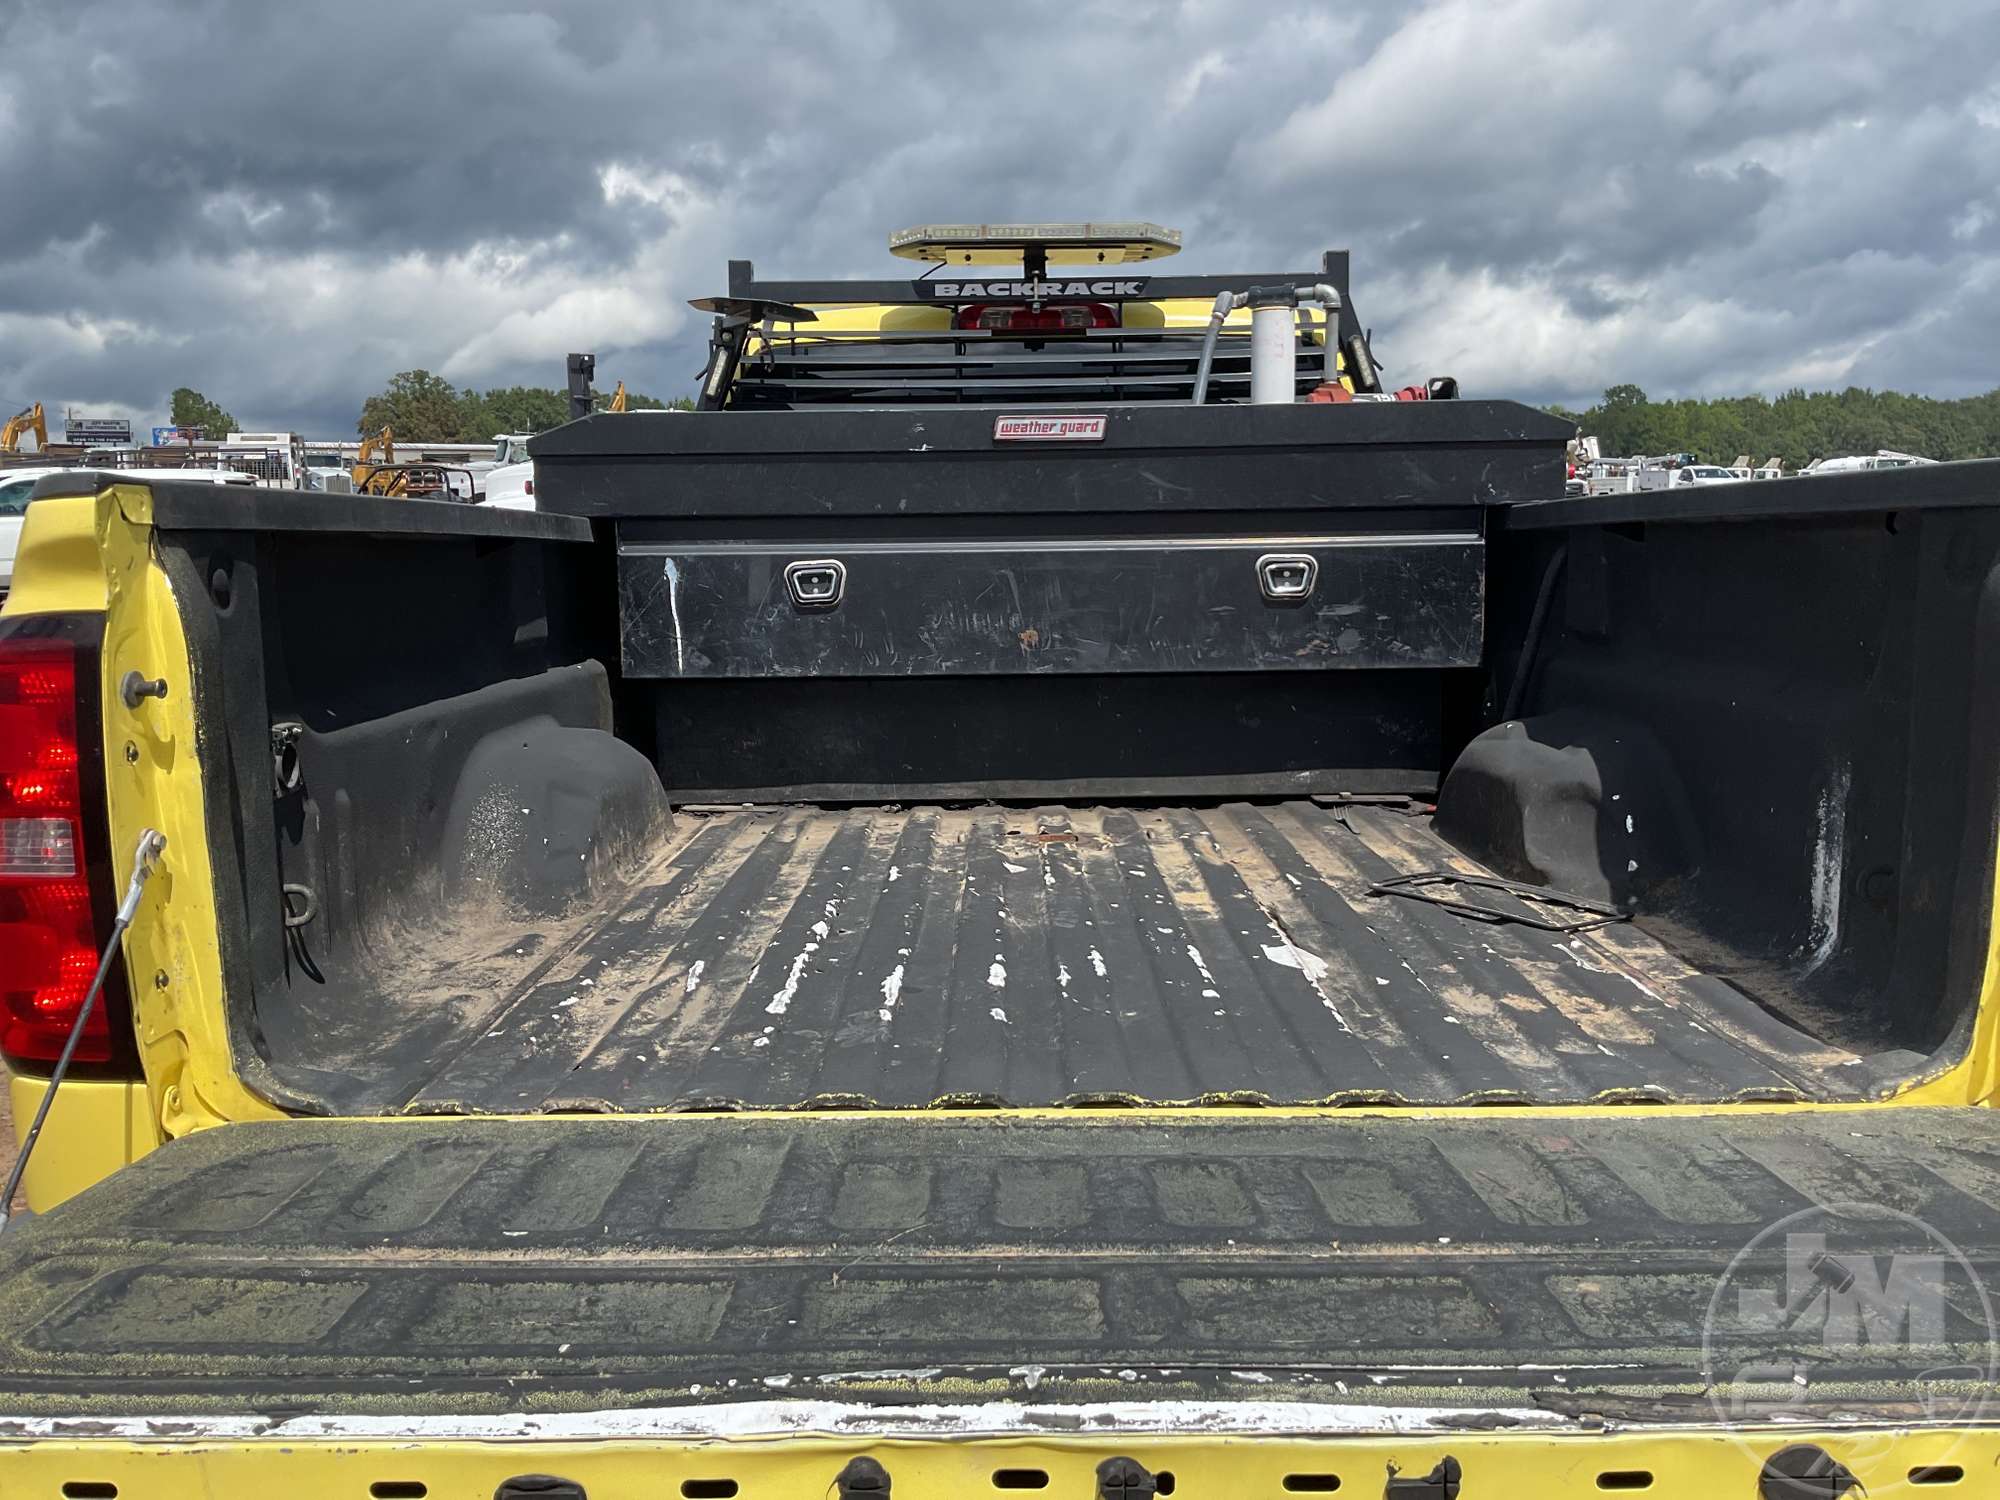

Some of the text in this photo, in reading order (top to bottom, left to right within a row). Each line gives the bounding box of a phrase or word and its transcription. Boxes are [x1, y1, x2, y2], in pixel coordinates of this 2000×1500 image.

[934, 282, 1140, 297] BACKRACK
[1000, 421, 1099, 436] weather guard
